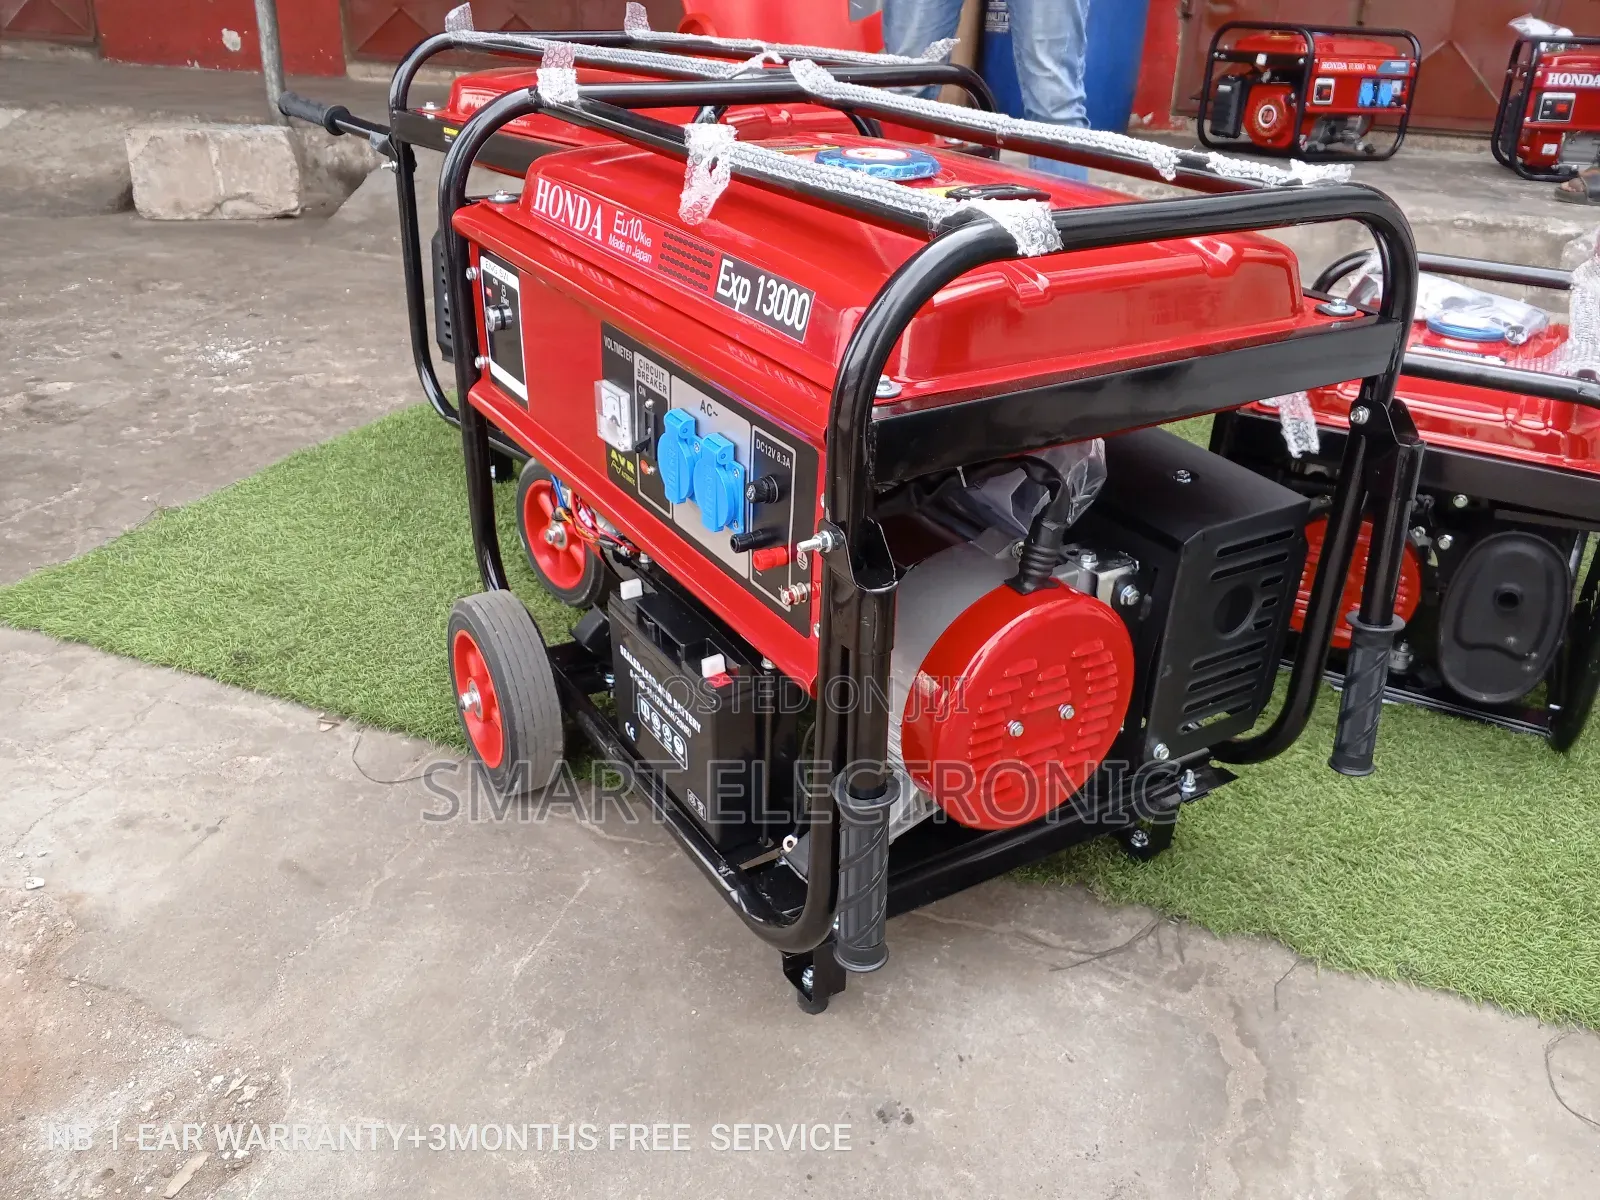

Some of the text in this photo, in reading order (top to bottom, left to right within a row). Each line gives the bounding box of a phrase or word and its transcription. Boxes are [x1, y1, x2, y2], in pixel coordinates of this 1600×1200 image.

[533, 177, 603, 241] HONDA
[608, 233, 653, 264] Made in Japan
[716, 258, 811, 331] Exp 13000
[603, 335, 633, 363] VOLTMETER
[637, 368, 668, 395] BREAKER
[638, 358, 665, 383] CIRCUIT
[638, 384, 647, 397] ON
[610, 448, 635, 475] AVR
[755, 438, 791, 470] DC12V 8.3A
[673, 698, 702, 734] BATTERY
